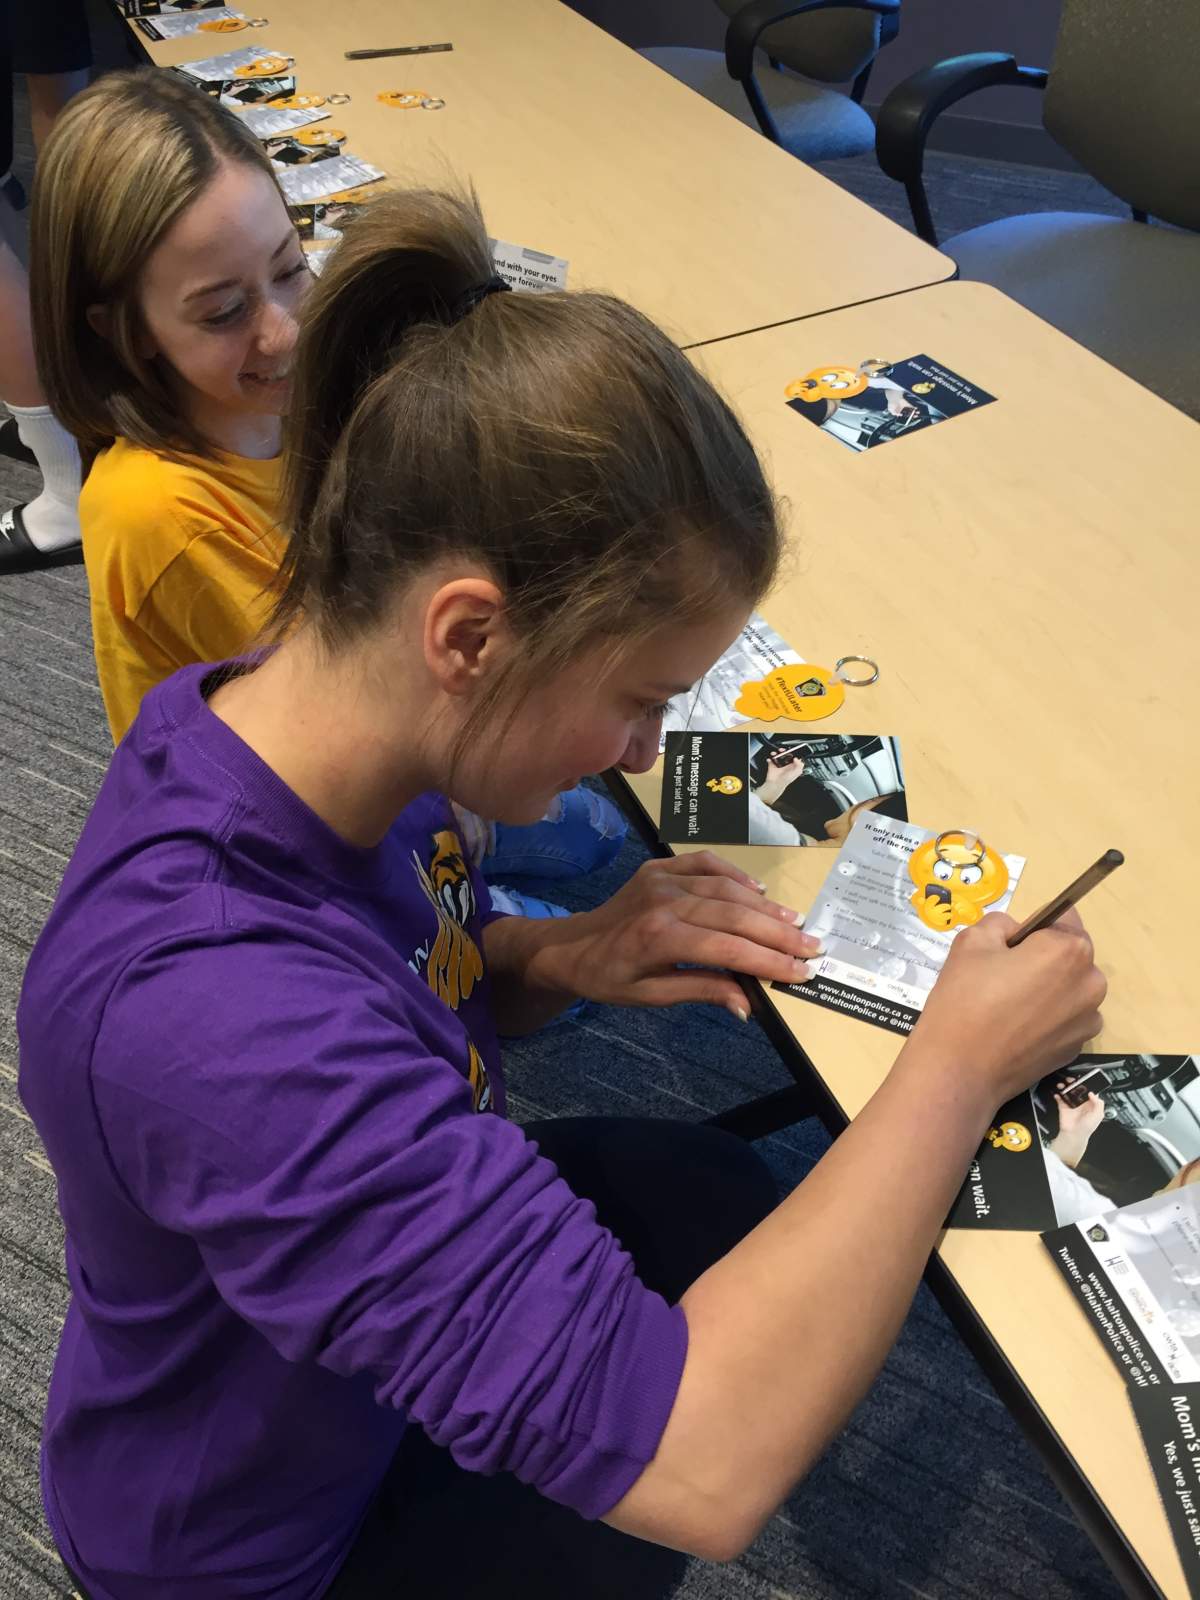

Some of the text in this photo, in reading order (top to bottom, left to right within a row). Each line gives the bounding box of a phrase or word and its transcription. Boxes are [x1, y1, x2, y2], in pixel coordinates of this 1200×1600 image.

[507, 262, 523, 272] with
[524, 267, 540, 278] your
[541, 273, 557, 283] eyes
[673, 775, 684, 787] just
[675, 765, 683, 775] we
[674, 787, 684, 800] said
[687, 736, 703, 837] Mom's message can wait.
[673, 800, 683, 815] that.
[872, 827, 890, 837] only
[891, 832, 913, 843] takes
[886, 838, 899, 849] the
[817, 982, 913, 1022] www.haltonpolice.ca or
[820, 993, 877, 1019] @HaltonPolice
[972, 1184, 990, 1218] wait.
[1058, 1246, 1085, 1283] Twitter:
[1080, 1283, 1125, 1352] @HaltonPolice
[1121, 1353, 1133, 1365] or
[1088, 1272, 1152, 1373] www.haltonpolice.ca
[1149, 1374, 1160, 1385] or
[1171, 1396, 1200, 1452] Mom's
[1163, 1440, 1178, 1465] Yes,
[1172, 1467, 1186, 1487] we
[1175, 1490, 1197, 1515] just
